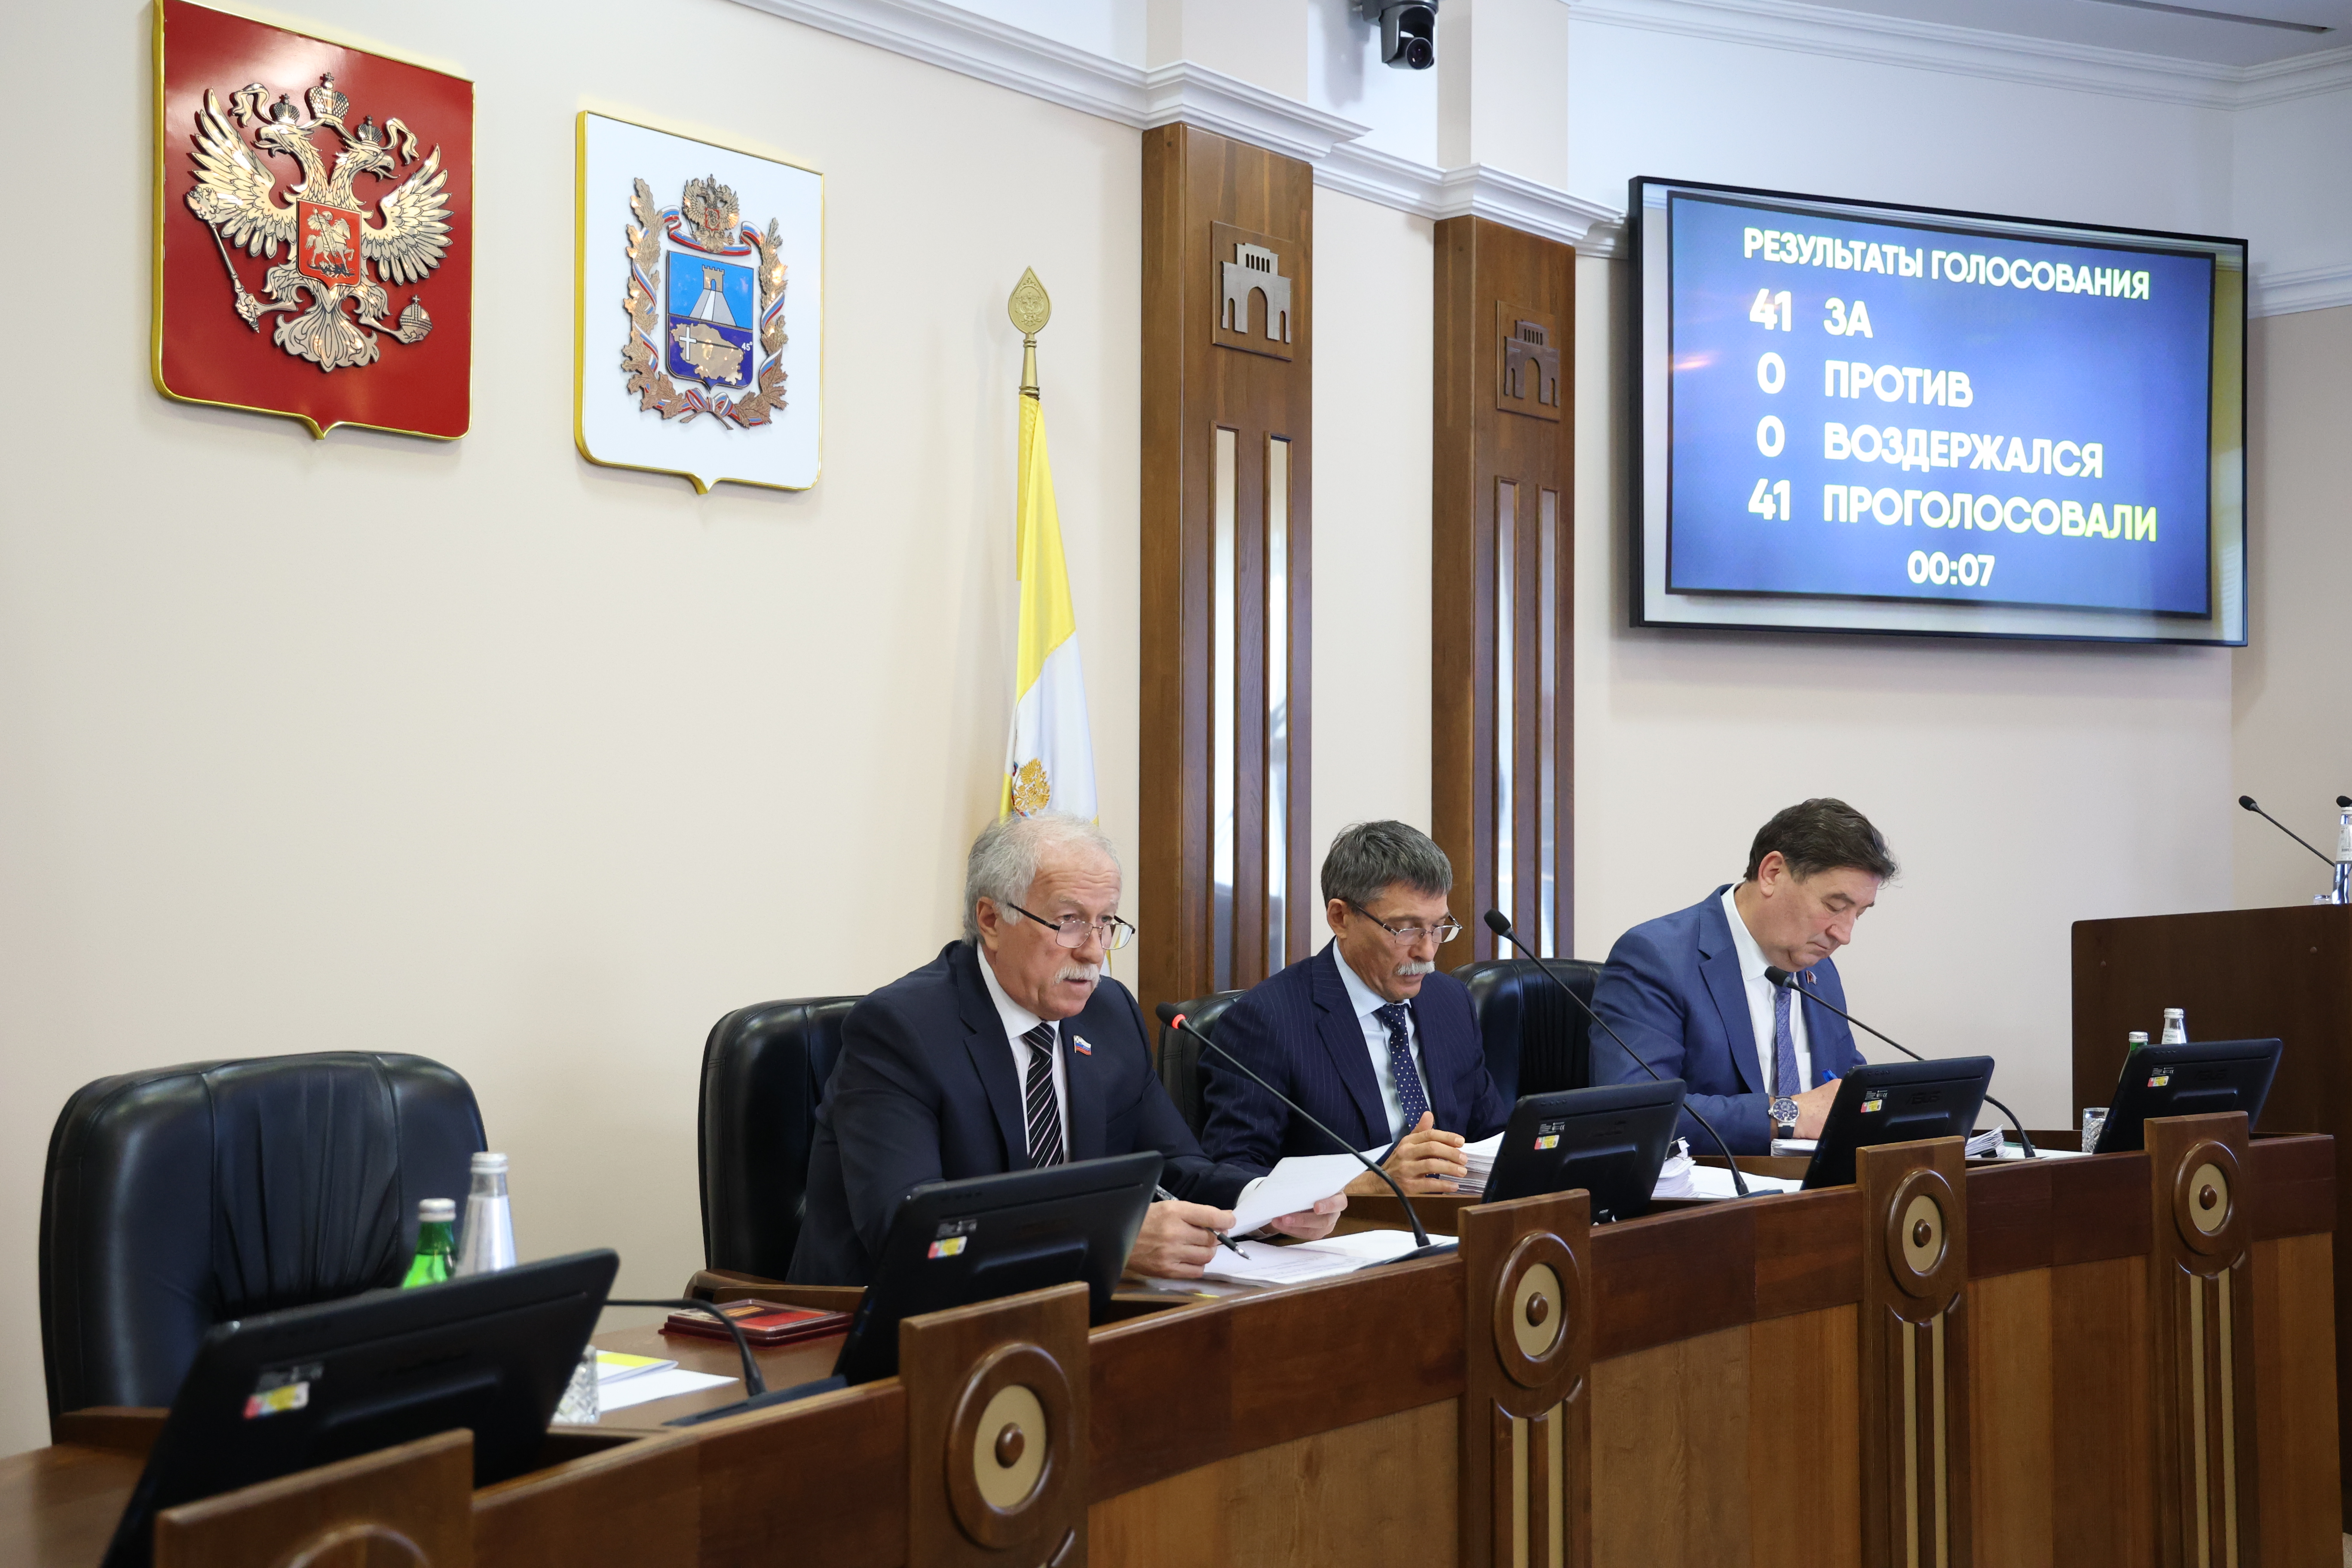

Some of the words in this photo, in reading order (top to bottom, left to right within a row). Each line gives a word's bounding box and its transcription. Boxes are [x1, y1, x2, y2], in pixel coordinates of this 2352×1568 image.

[1744, 227, 1923, 278] РЕЗУЛЬТАТЫ
[1932, 250, 2149, 300] ГОЛОСОВАНИЯ
[1749, 288, 1792, 332] 41
[1823, 297, 1874, 338] ЗА
[1757, 352, 1786, 394] 0
[1825, 359, 1973, 408] ПРОТИВ
[1756, 415, 1785, 457] 0
[1824, 422, 2103, 478] ВОЗДЕРЖАЛСЯ
[1748, 478, 1790, 521] 41
[1824, 484, 2156, 542] ПРОГОЛОСОВАЛИ
[1907, 550, 1995, 586] 00:07
